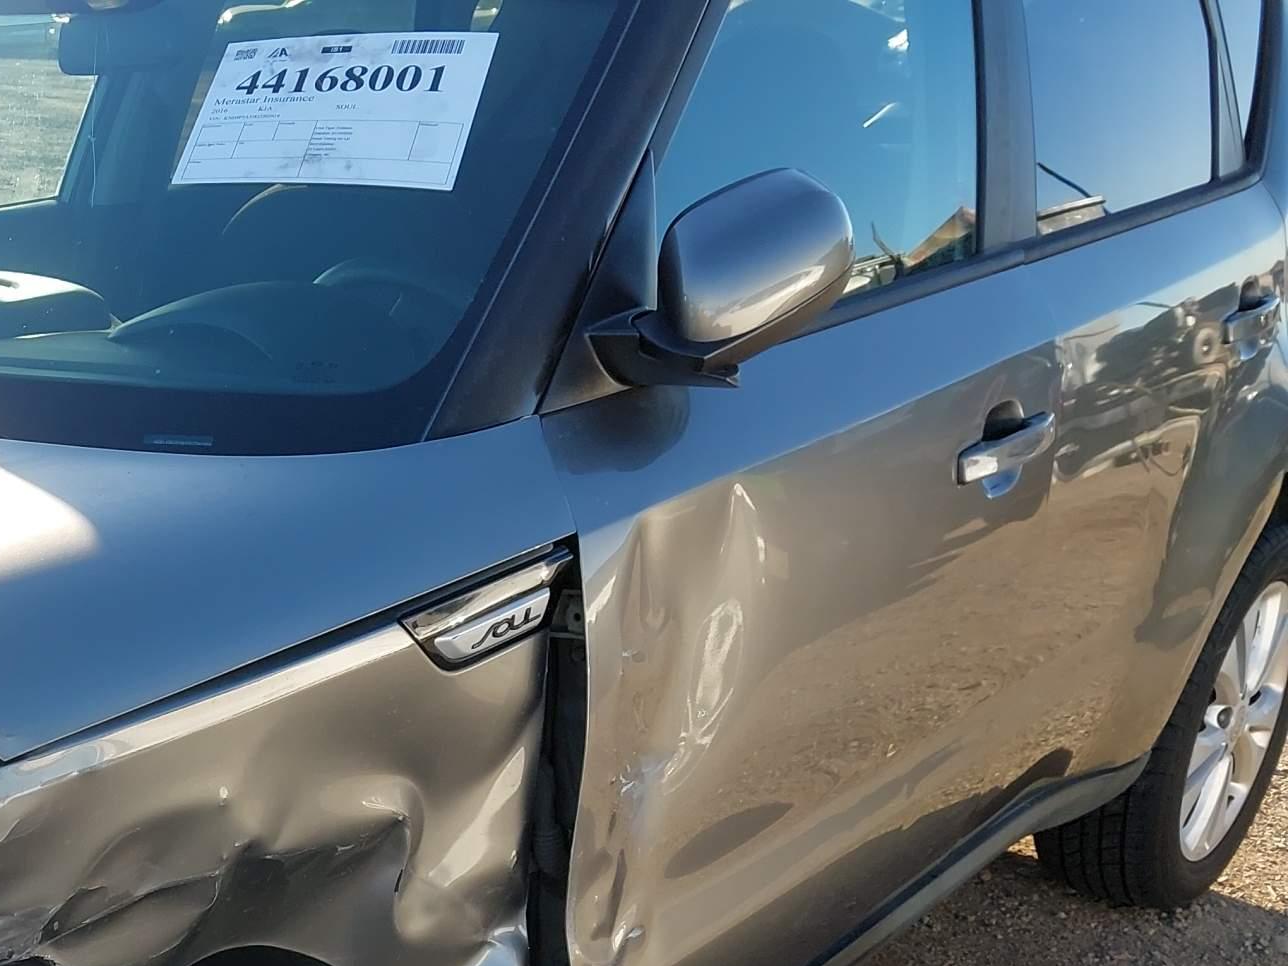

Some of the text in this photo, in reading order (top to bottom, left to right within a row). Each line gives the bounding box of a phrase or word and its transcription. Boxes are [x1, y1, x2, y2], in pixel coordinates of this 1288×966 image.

[235, 64, 448, 95] 44168001
[214, 95, 316, 107] Merastar Insurance
